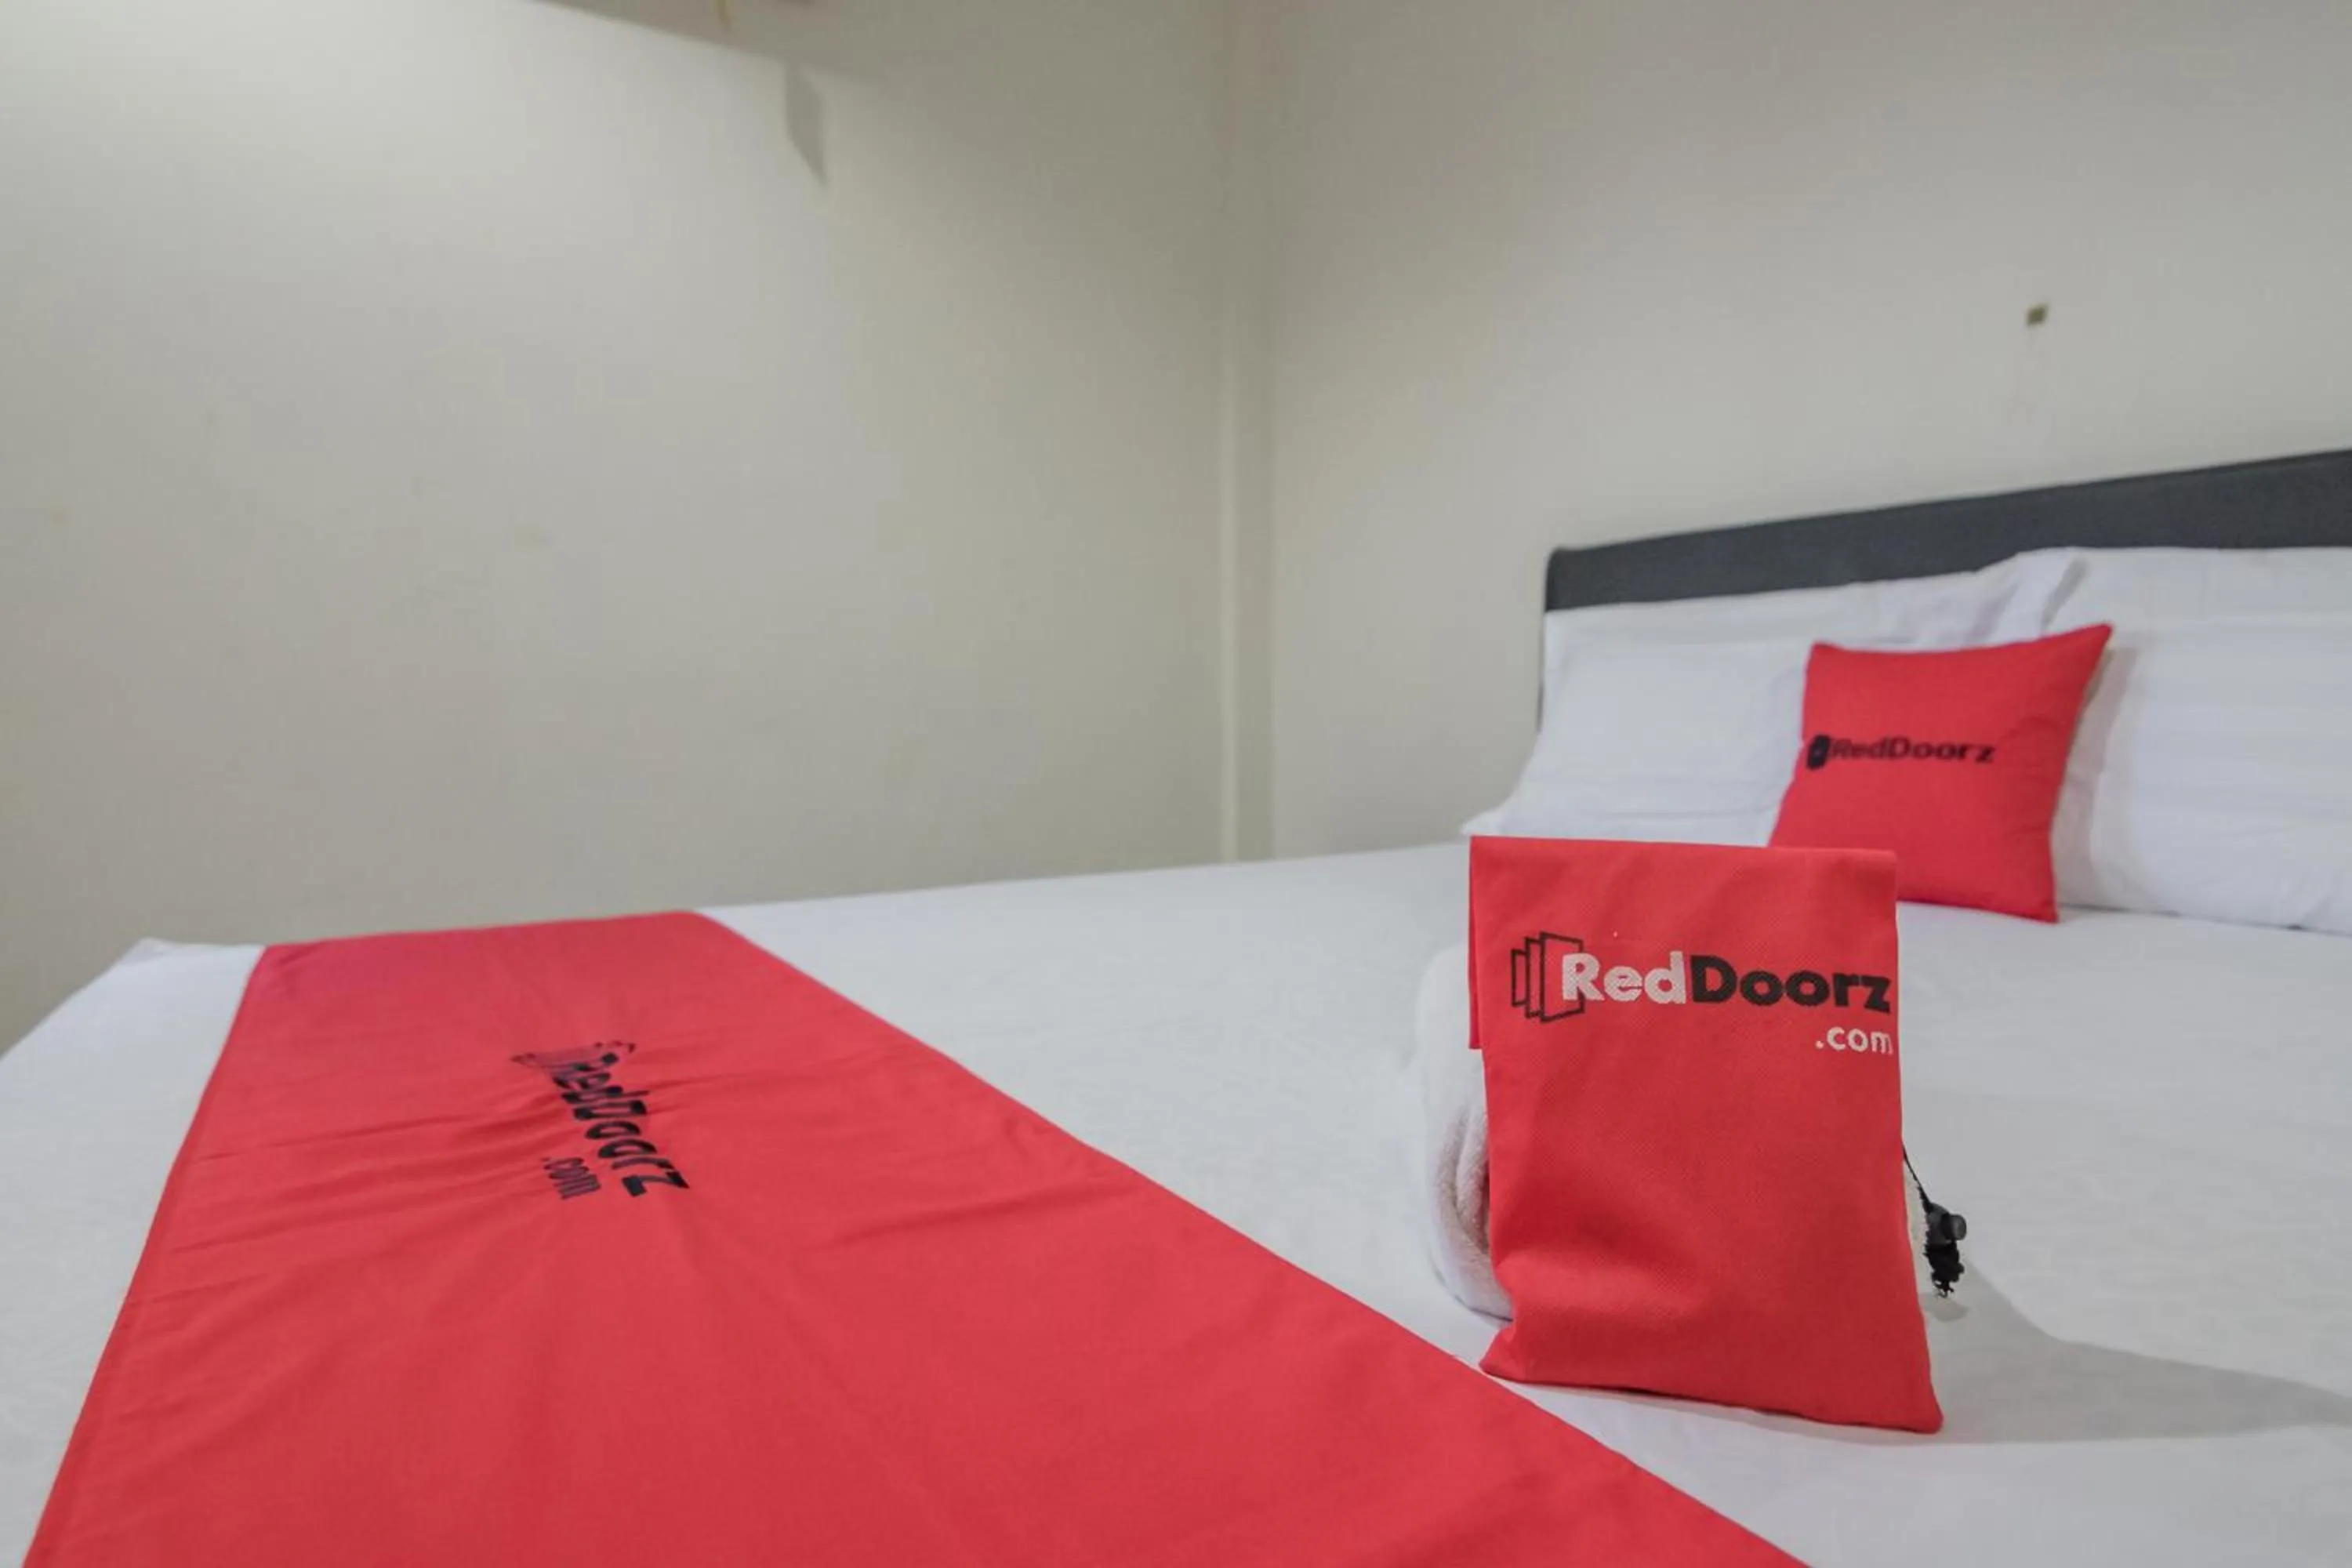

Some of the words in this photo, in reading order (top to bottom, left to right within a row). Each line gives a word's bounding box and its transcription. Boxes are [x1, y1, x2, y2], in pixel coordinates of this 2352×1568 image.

[1831, 735, 1996, 764] RedDoorz
[1560, 950, 1892, 1014] RedDoorz
[1815, 1025, 1893, 1054] .com
